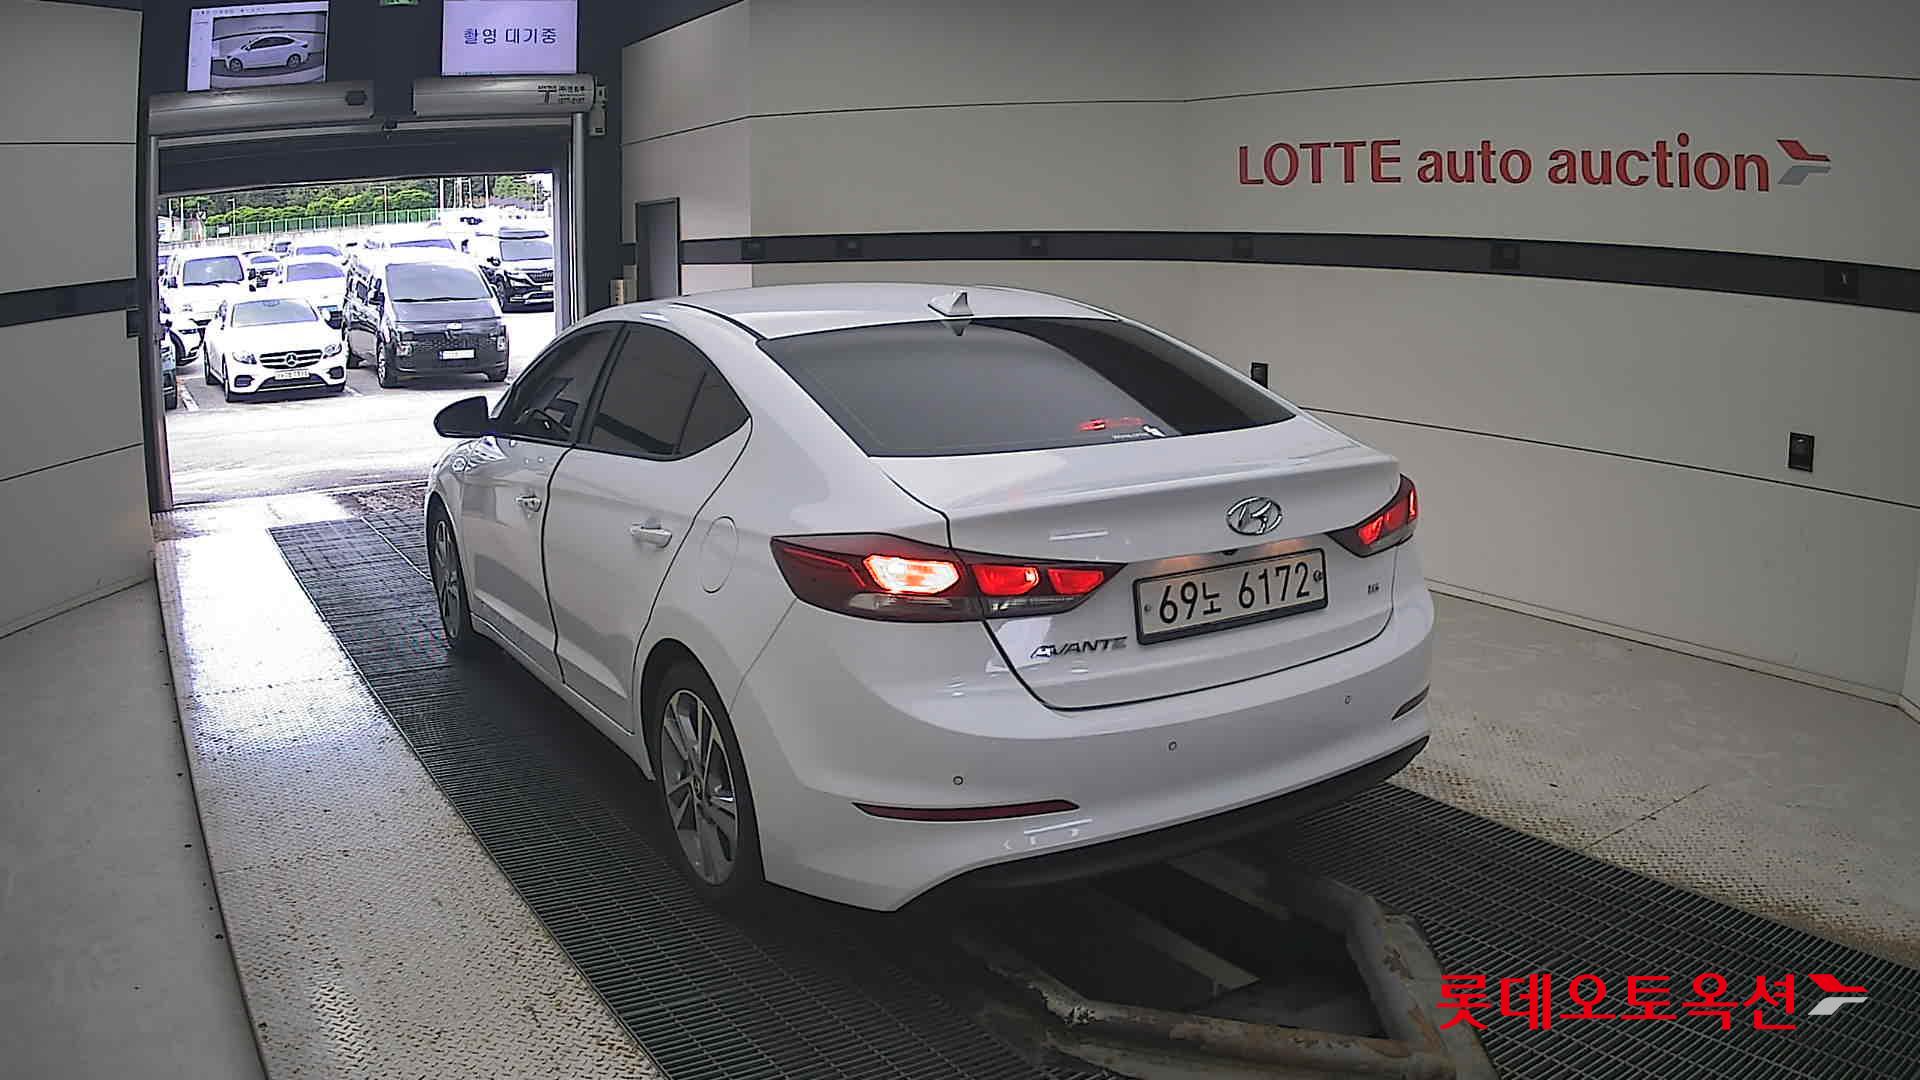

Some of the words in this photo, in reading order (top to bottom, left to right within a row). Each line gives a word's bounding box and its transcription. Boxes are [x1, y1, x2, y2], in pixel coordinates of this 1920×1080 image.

[505, 27, 557, 45] 대기중
[1238, 139, 1402, 186] LOTTE
[1416, 139, 1533, 186] auto
[1547, 133, 1771, 192] auction
[1159, 580, 1222, 625] 69노
[1238, 561, 1310, 610] 6172
[1030, 635, 1128, 659] AVANTE
